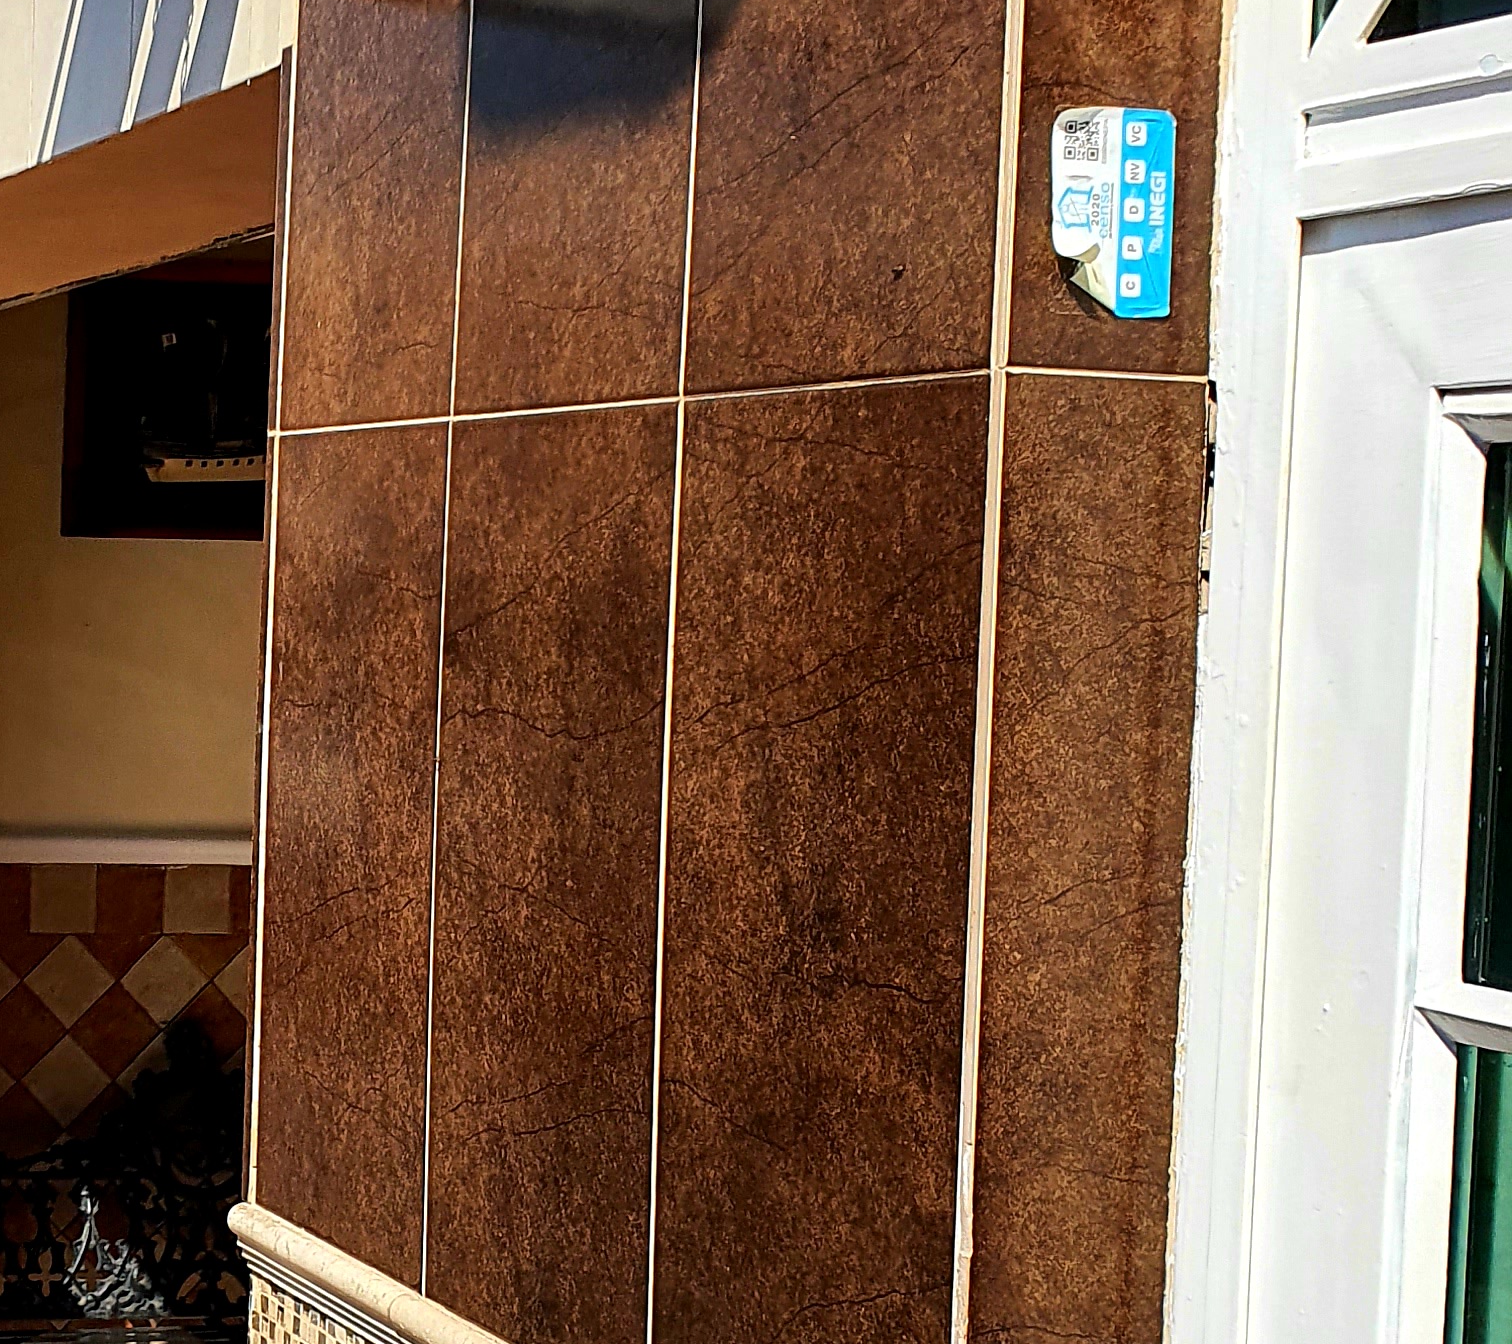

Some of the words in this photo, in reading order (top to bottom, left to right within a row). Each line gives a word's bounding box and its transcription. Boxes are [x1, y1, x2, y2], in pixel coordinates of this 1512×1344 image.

[1130, 124, 1142, 144] VC
[1130, 162, 1141, 181] NV
[1148, 170, 1167, 228] INEGI
[1091, 193, 1102, 227] 2020
[1099, 181, 1110, 240] censo
[1128, 205, 1140, 215] D
[1127, 243, 1138, 253] P
[1125, 281, 1136, 291] C
